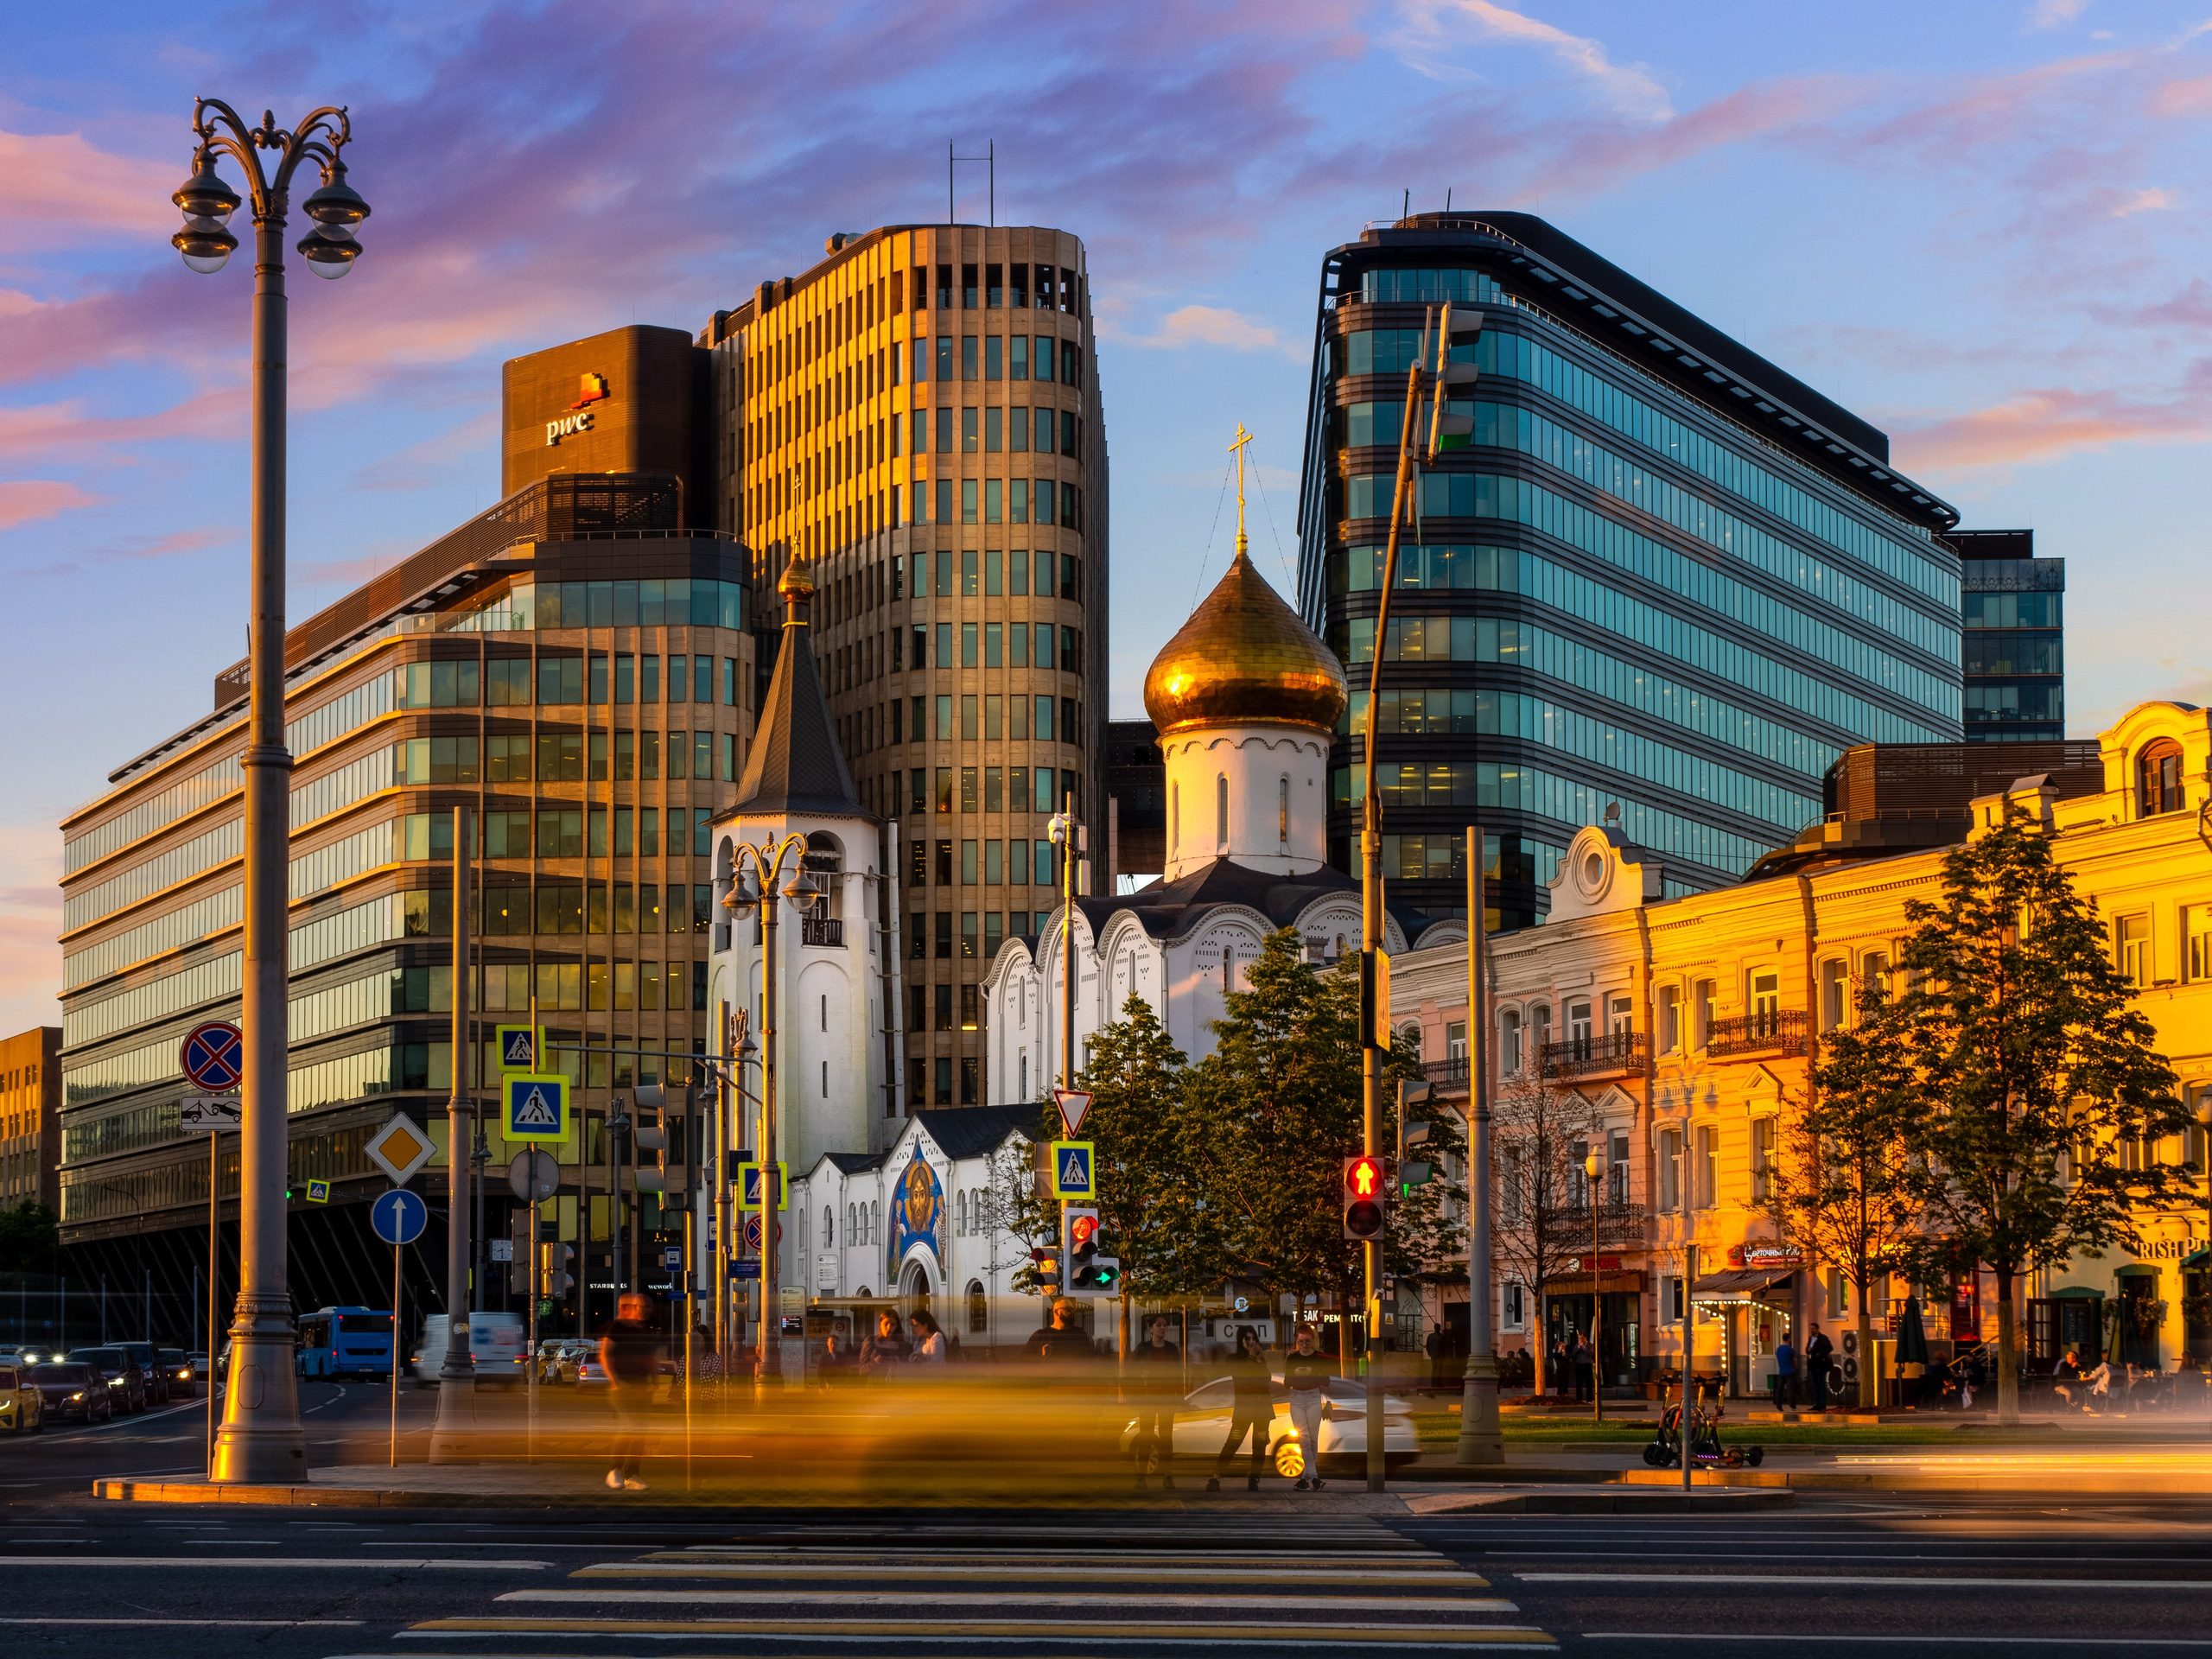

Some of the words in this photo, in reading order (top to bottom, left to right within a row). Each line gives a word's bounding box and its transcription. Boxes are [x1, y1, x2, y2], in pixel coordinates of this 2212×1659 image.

[546, 413, 588, 446] pwc
[1293, 1310, 1318, 1322] ТБАК
[1224, 1325, 1267, 1338] СП
